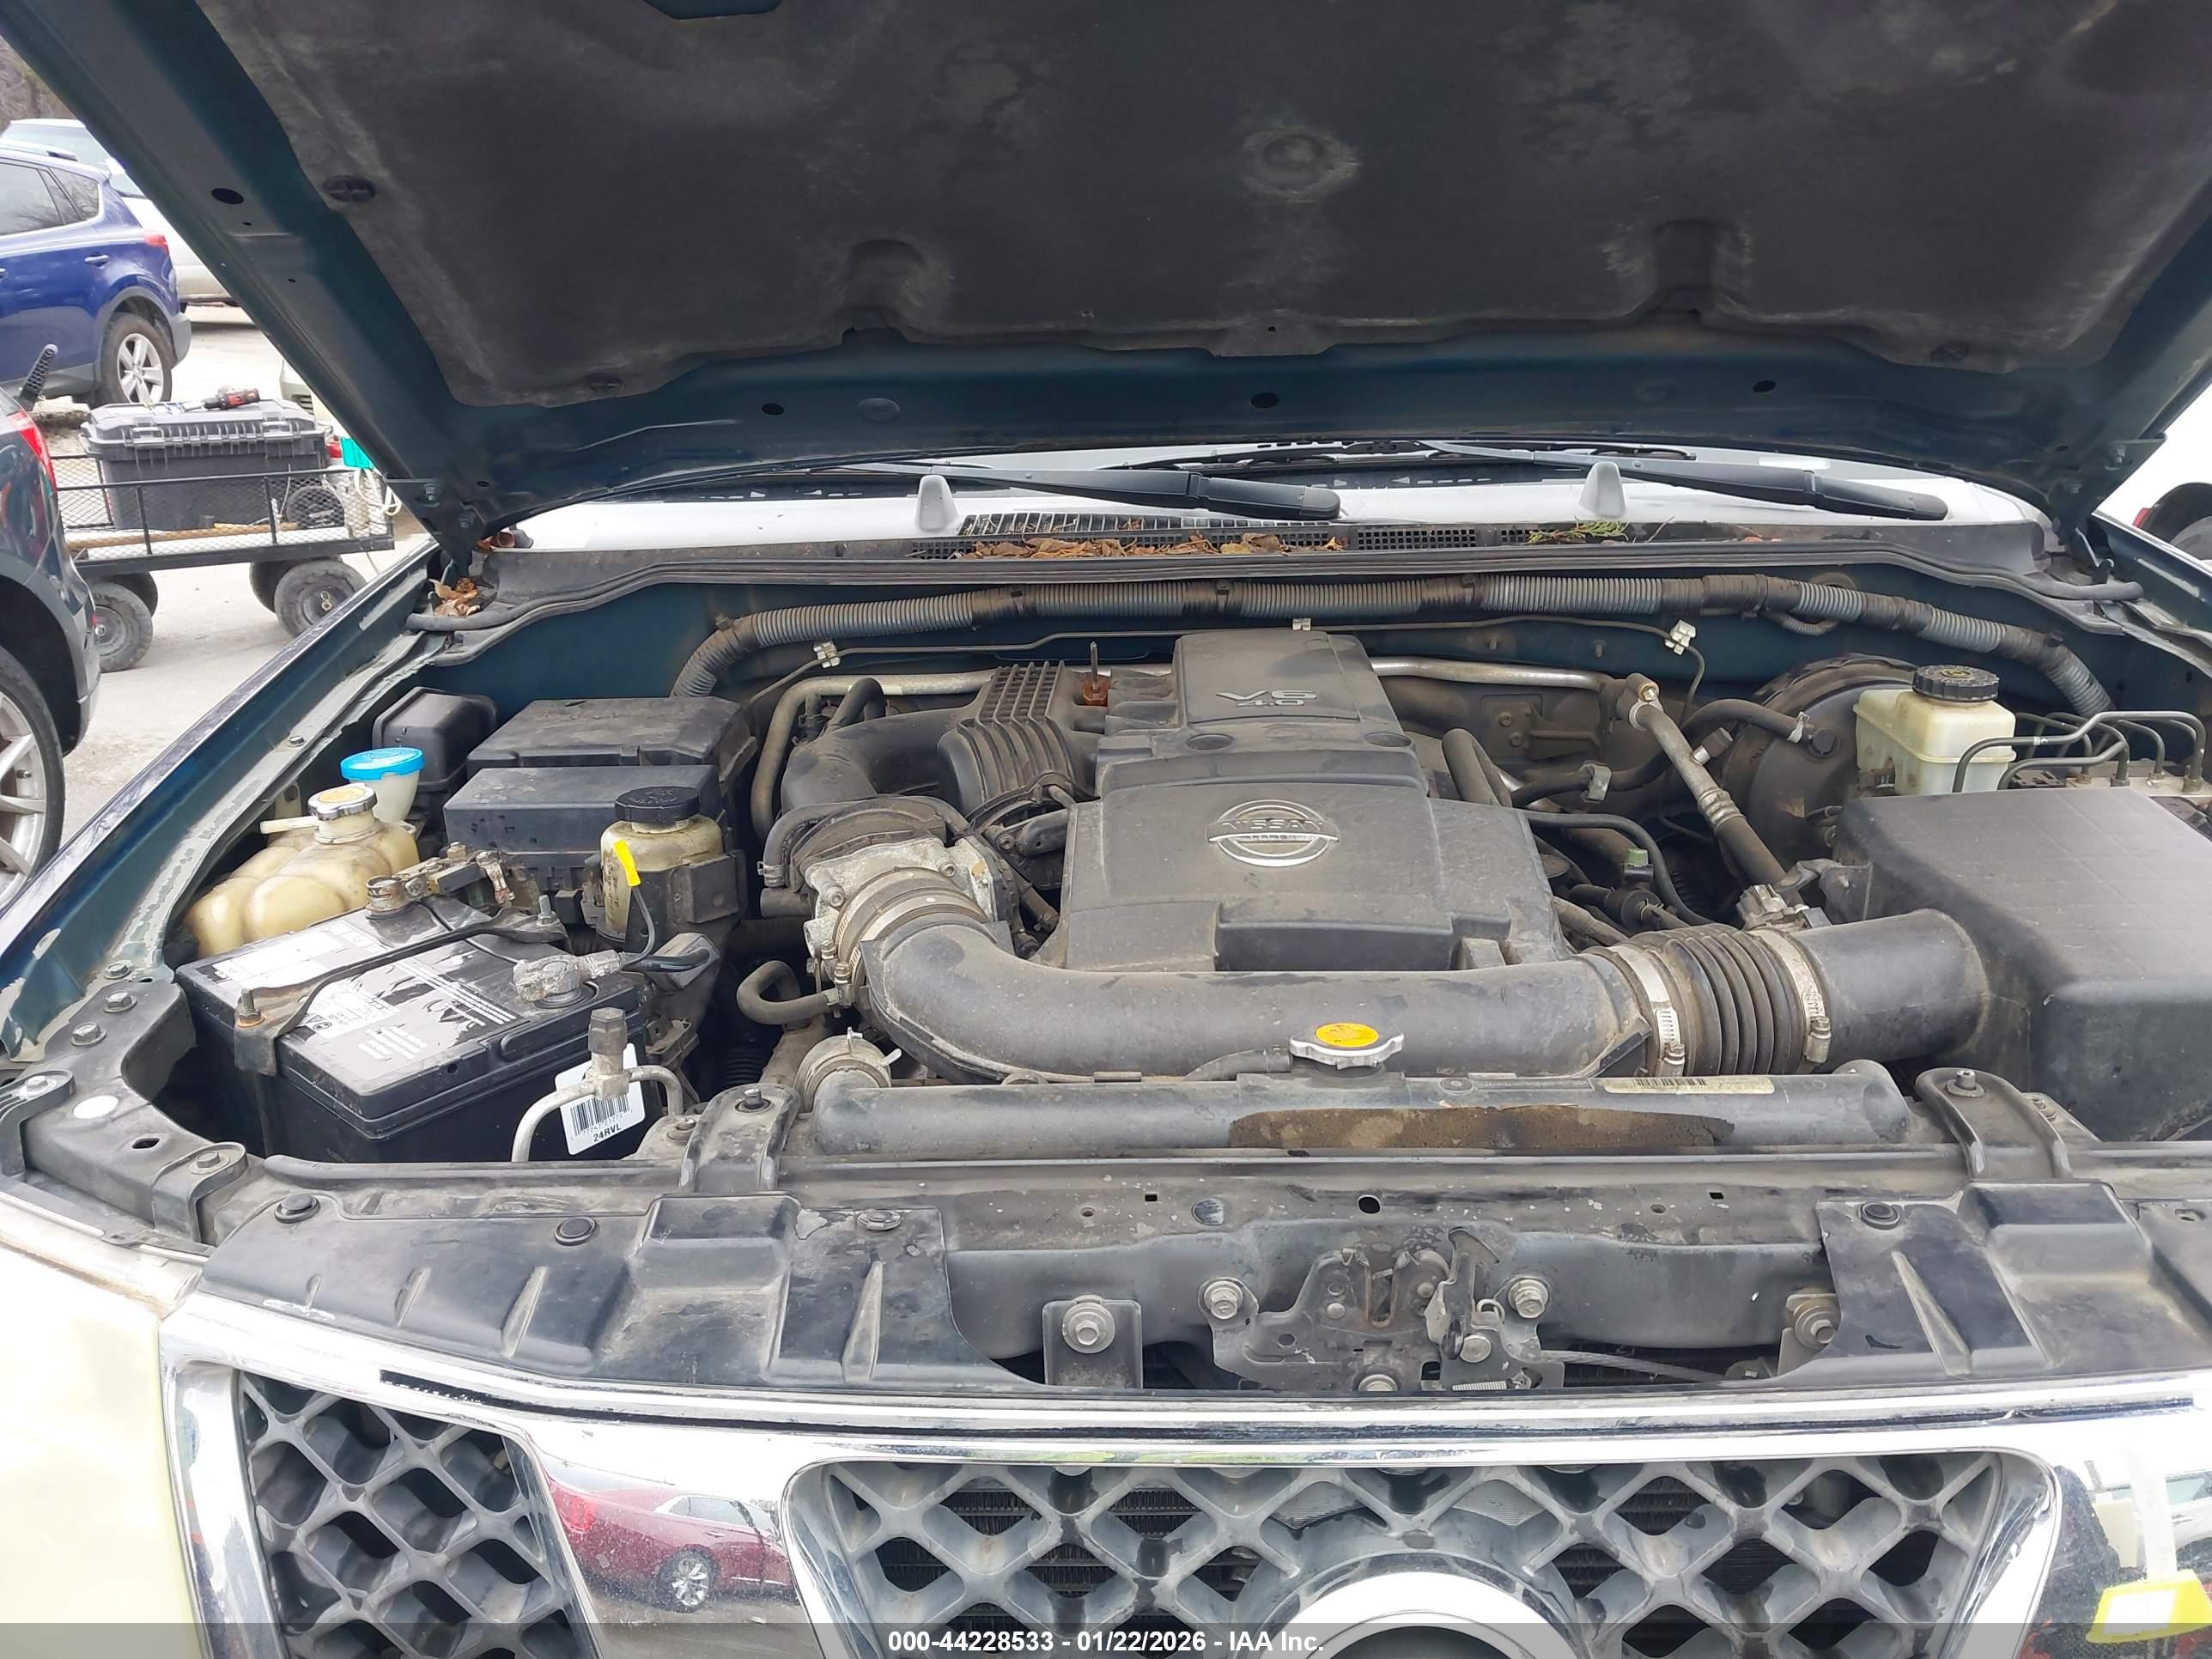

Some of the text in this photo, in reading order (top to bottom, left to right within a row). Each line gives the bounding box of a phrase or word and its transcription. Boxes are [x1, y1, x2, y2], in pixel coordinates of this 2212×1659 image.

[1216, 690, 1317, 701] V6
[1221, 818, 1325, 831] NISSAN
[592, 1123, 622, 1142] 24RVL
